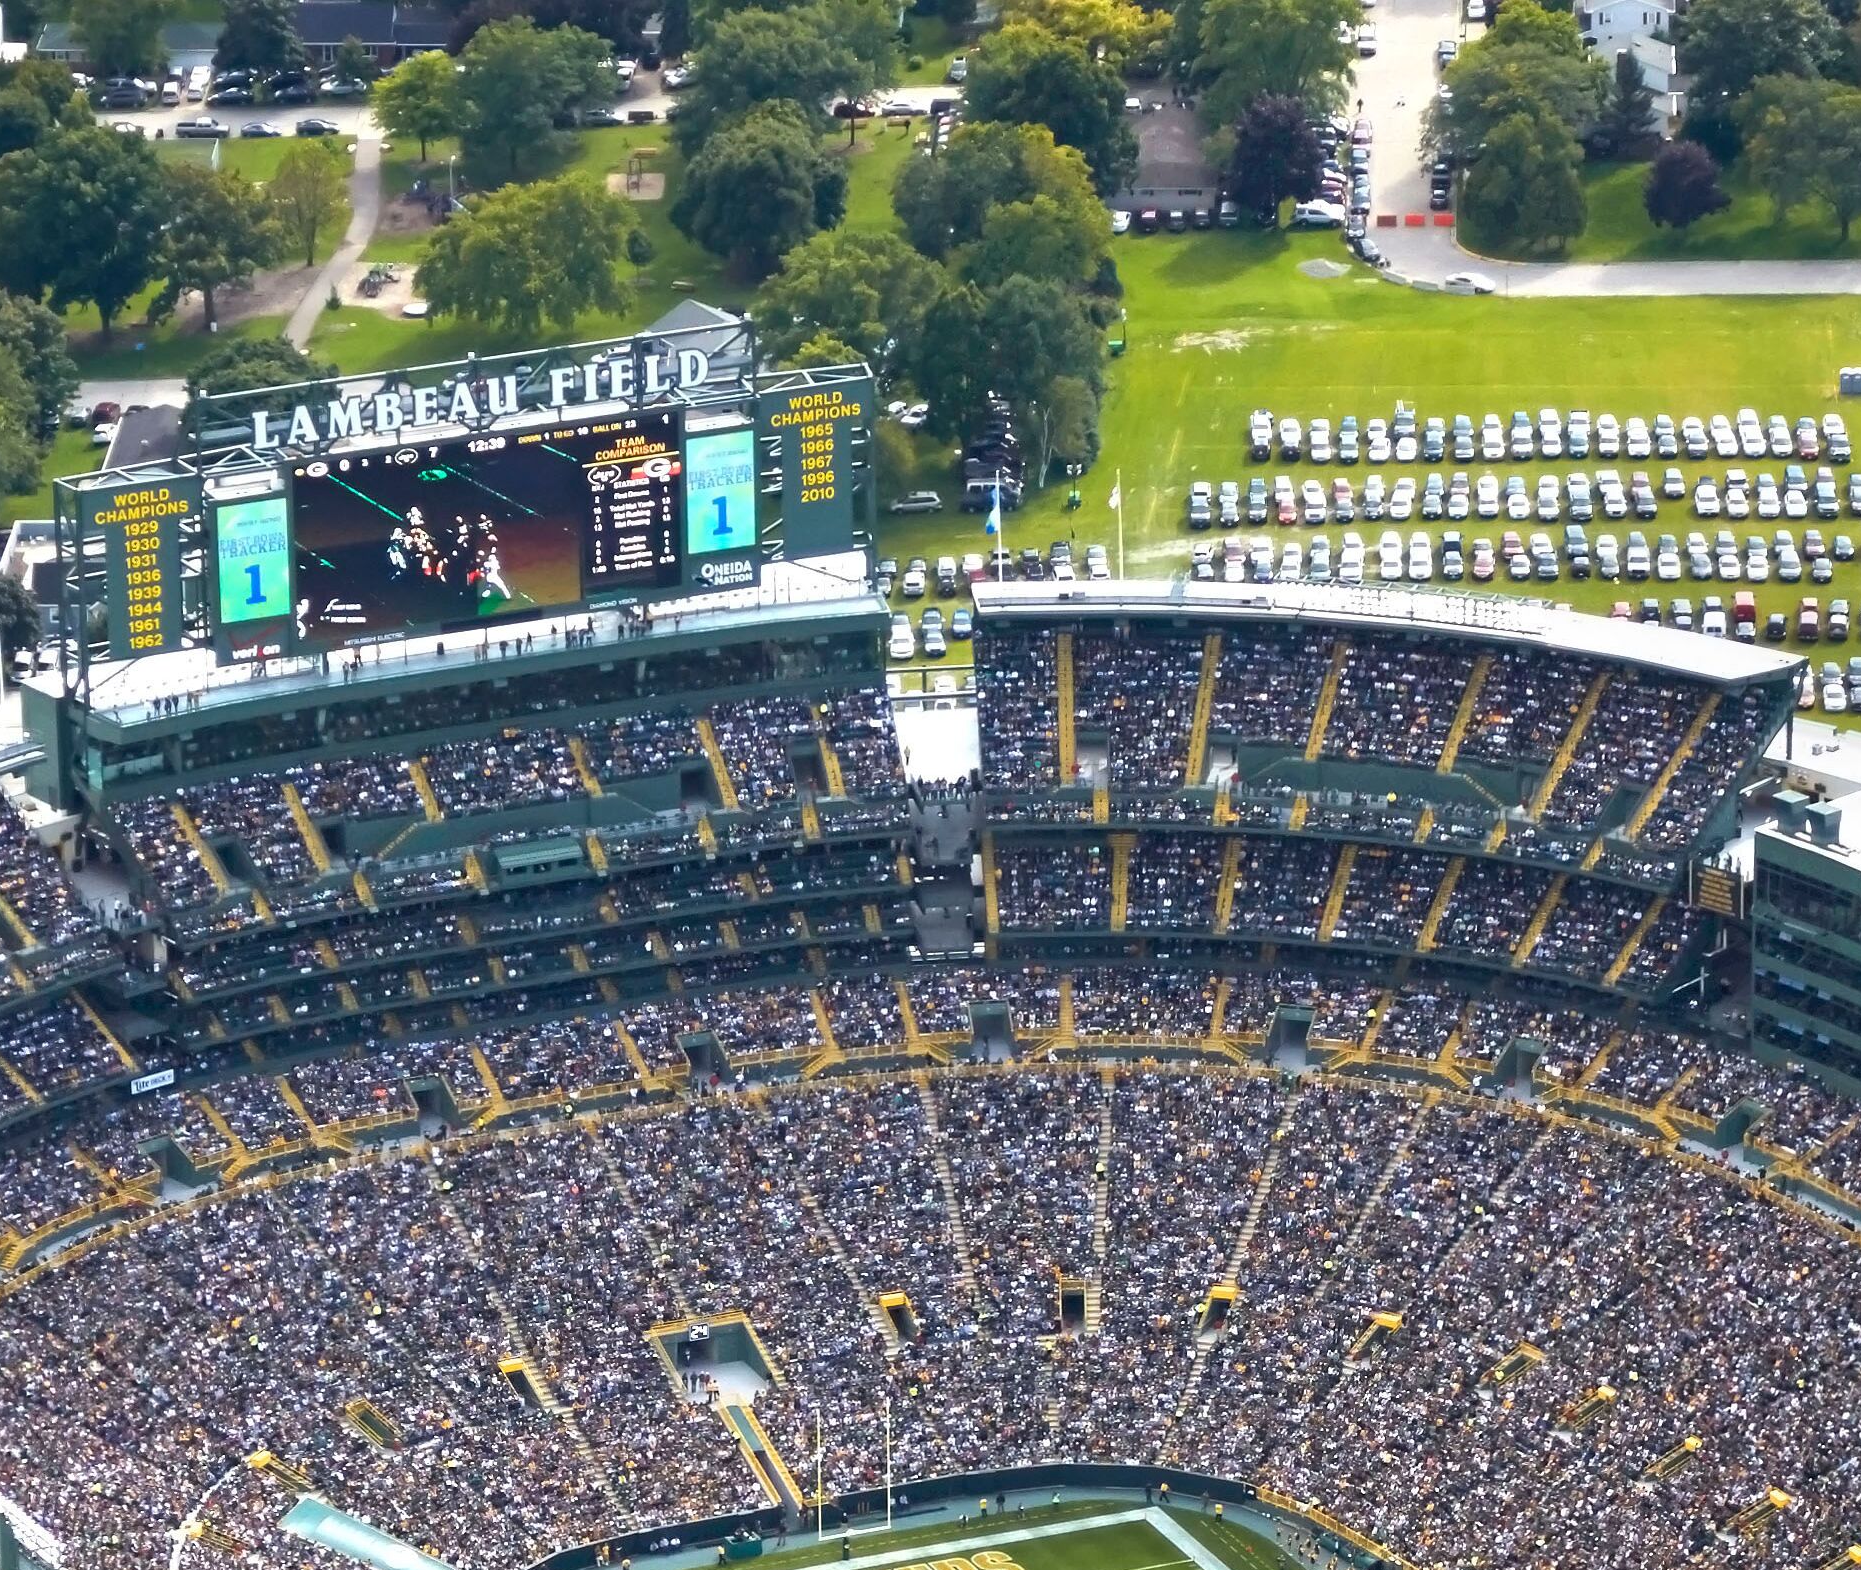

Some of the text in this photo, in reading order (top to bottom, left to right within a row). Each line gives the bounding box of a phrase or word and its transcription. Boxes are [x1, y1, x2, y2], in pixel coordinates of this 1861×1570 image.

[251, 349, 709, 449] LAMBEAU FIELD
[788, 391, 843, 409] WORLD
[770, 403, 861, 427] CHAMPIONS
[800, 423, 834, 439] 1965
[428, 446, 438, 458] 7
[468, 437, 506, 452] 12:39
[615, 436, 644, 447] TEAM
[800, 438, 834, 454] 1966
[595, 442, 665, 461] COMPARISON
[801, 455, 833, 471] 1967
[688, 472, 754, 491] TRACKER
[801, 470, 835, 487] 1996
[113, 488, 169, 508] WORLD
[801, 486, 835, 503] 2010
[94, 500, 189, 525] CHAMPIONS
[712, 496, 733, 536] 1
[124, 521, 159, 537] 1929
[124, 537, 160, 553] 1930
[221, 541, 286, 560] TRACKER
[125, 554, 157, 569] 1931
[701, 561, 753, 577] ONEIDA
[126, 569, 161, 585] 1936
[244, 564, 267, 606] 1
[714, 573, 753, 586] NATION
[127, 586, 162, 601] 1939
[128, 602, 163, 617] 1944
[129, 618, 160, 633] 1961
[129, 634, 163, 649] 1962
[232, 644, 281, 660] verizon
